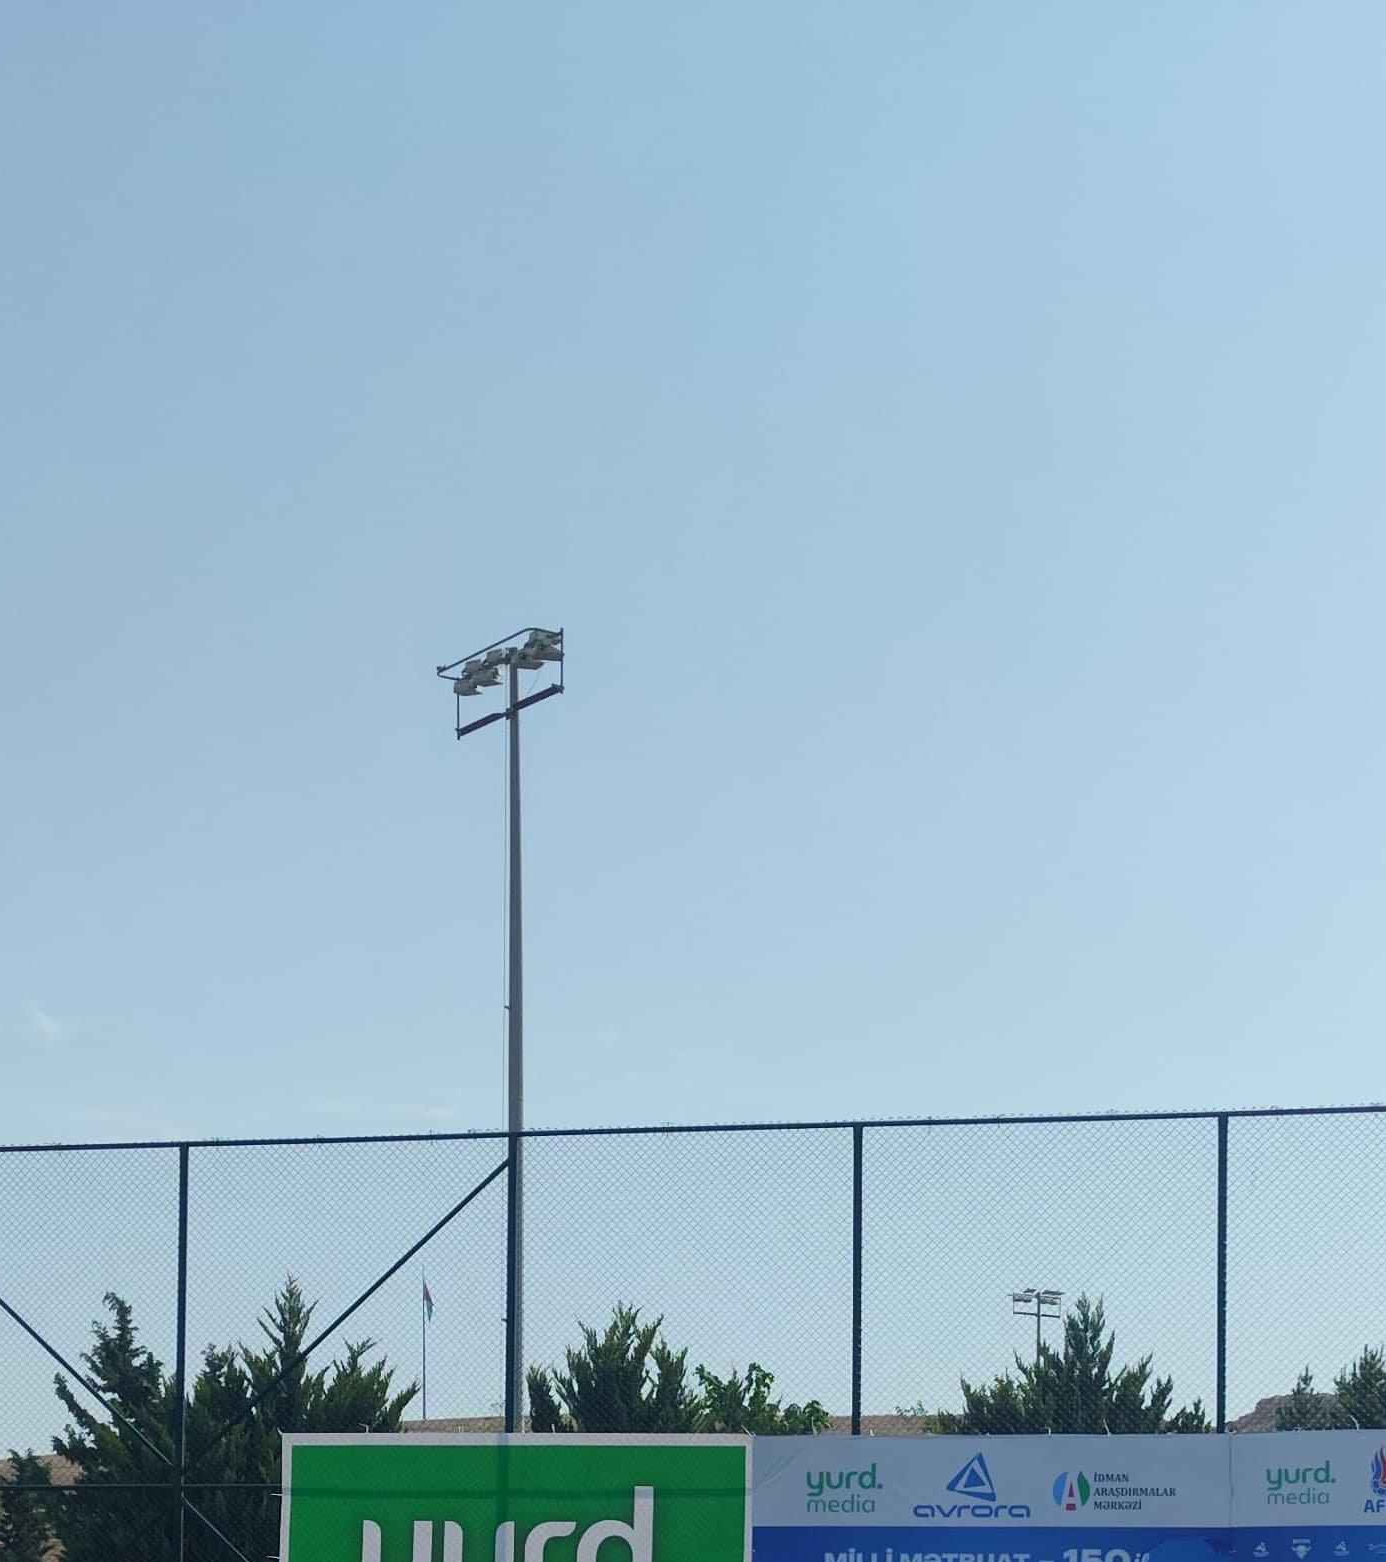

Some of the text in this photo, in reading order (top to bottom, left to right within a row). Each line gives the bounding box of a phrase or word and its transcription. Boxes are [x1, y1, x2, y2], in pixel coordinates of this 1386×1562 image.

[806, 1462, 883, 1497] yurd.
[1094, 1472, 1129, 1482] İDMAN
[1266, 1460, 1336, 1490] yurd.
[1093, 1488, 1176, 1498] ARAŞDIRMALAR
[1267, 1487, 1329, 1505] media
[807, 1494, 875, 1513] media
[913, 1504, 1031, 1518] avrora
